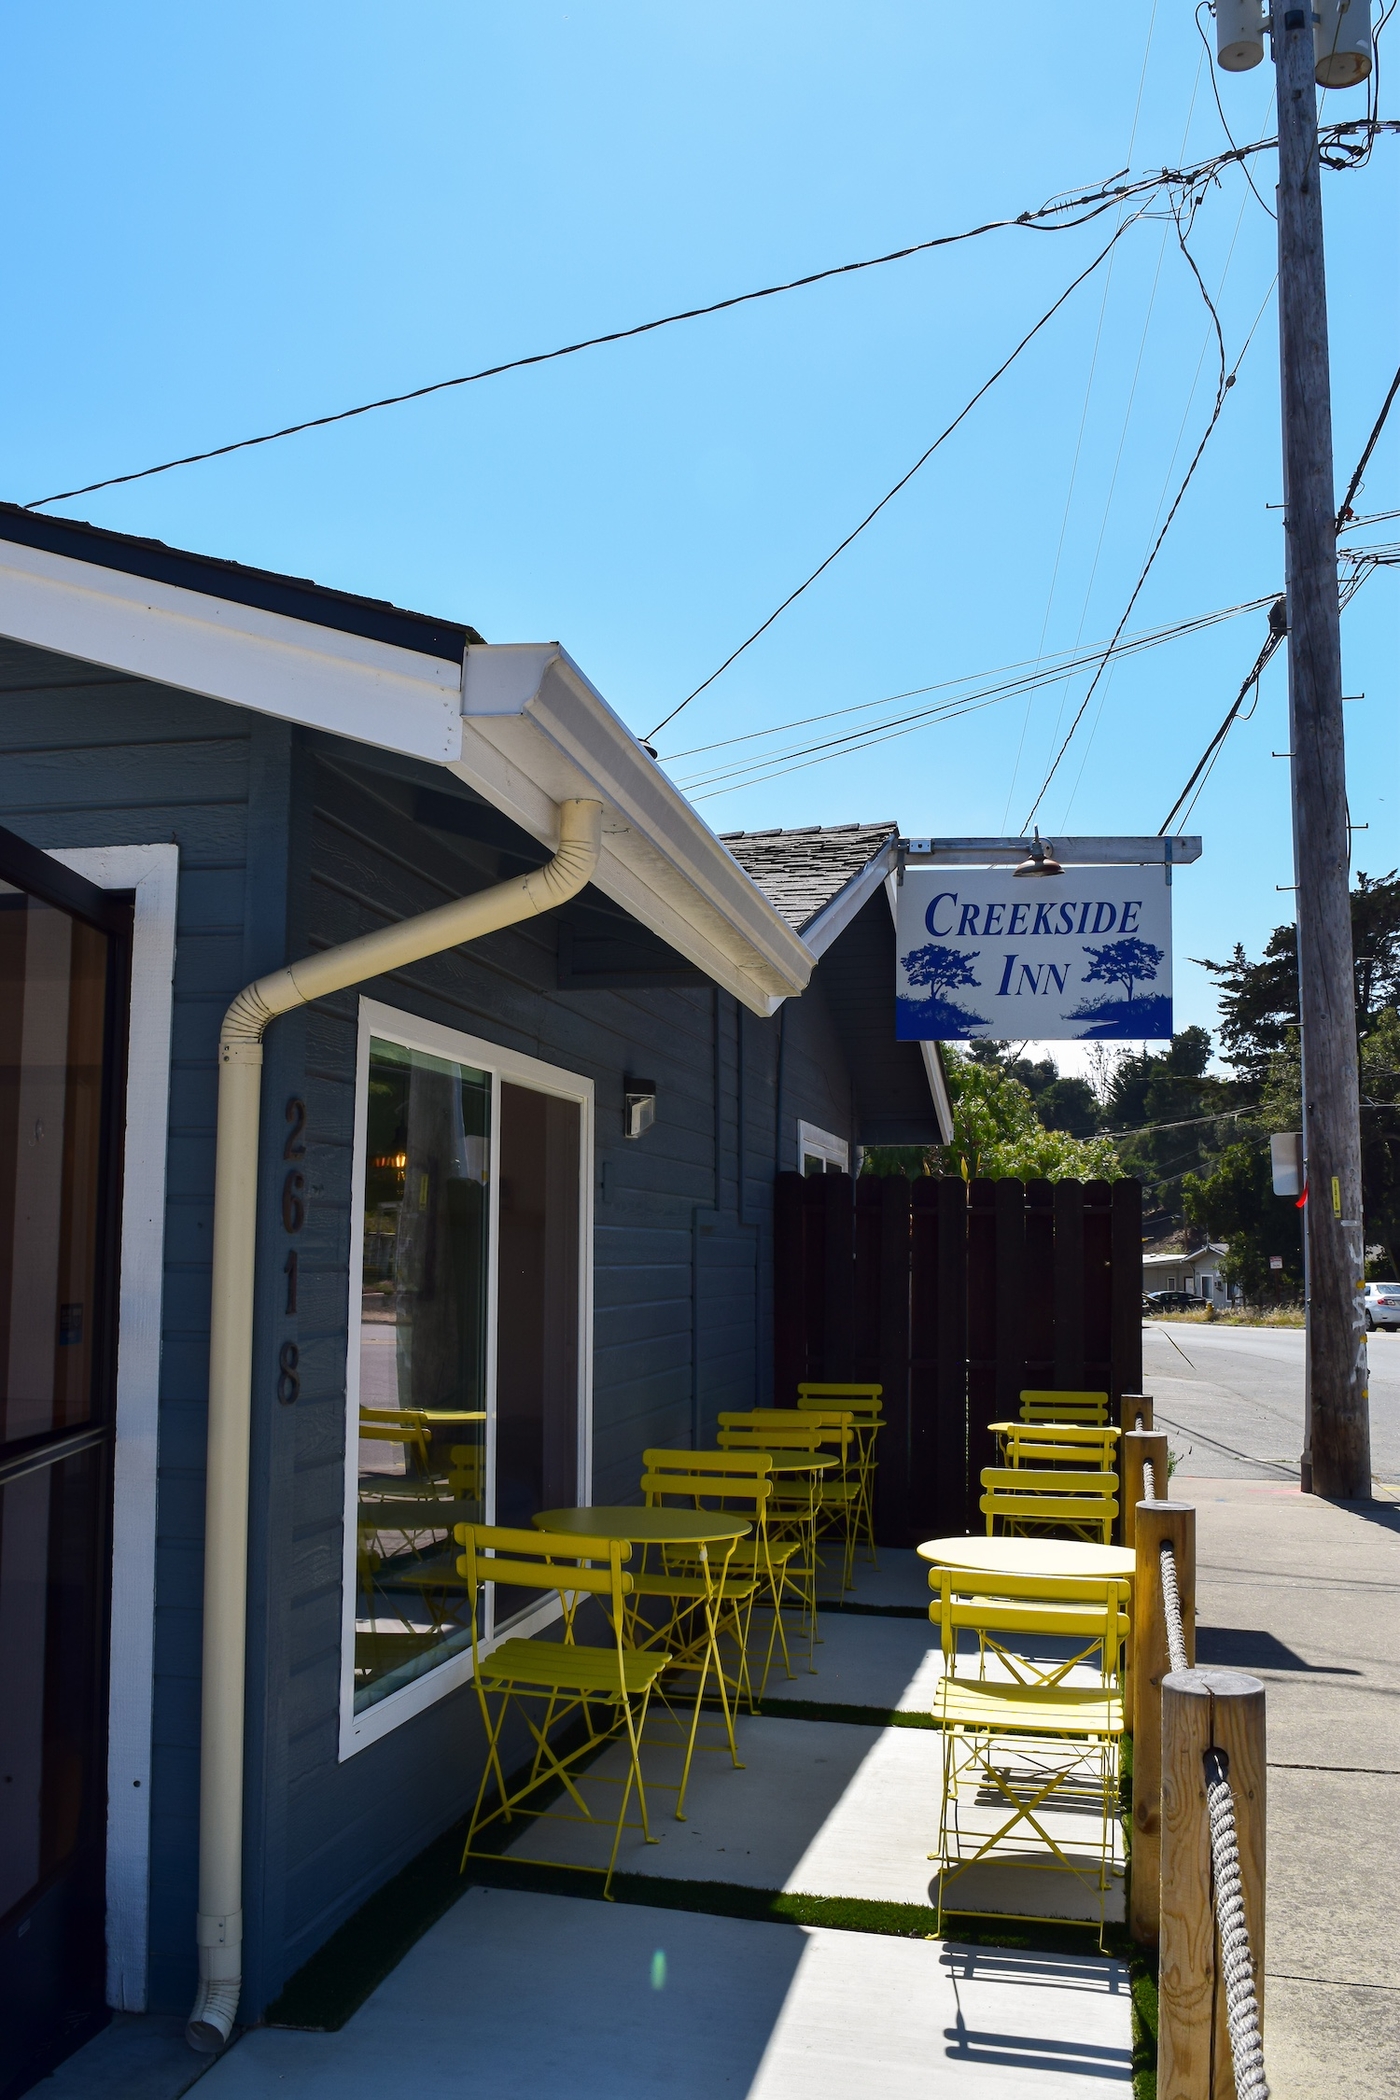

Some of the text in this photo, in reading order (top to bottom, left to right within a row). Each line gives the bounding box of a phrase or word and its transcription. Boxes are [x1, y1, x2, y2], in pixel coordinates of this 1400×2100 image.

[925, 892, 1142, 937] CREEKSIDE
[995, 954, 1071, 996] INN
[278, 1097, 306, 1405] 2618
